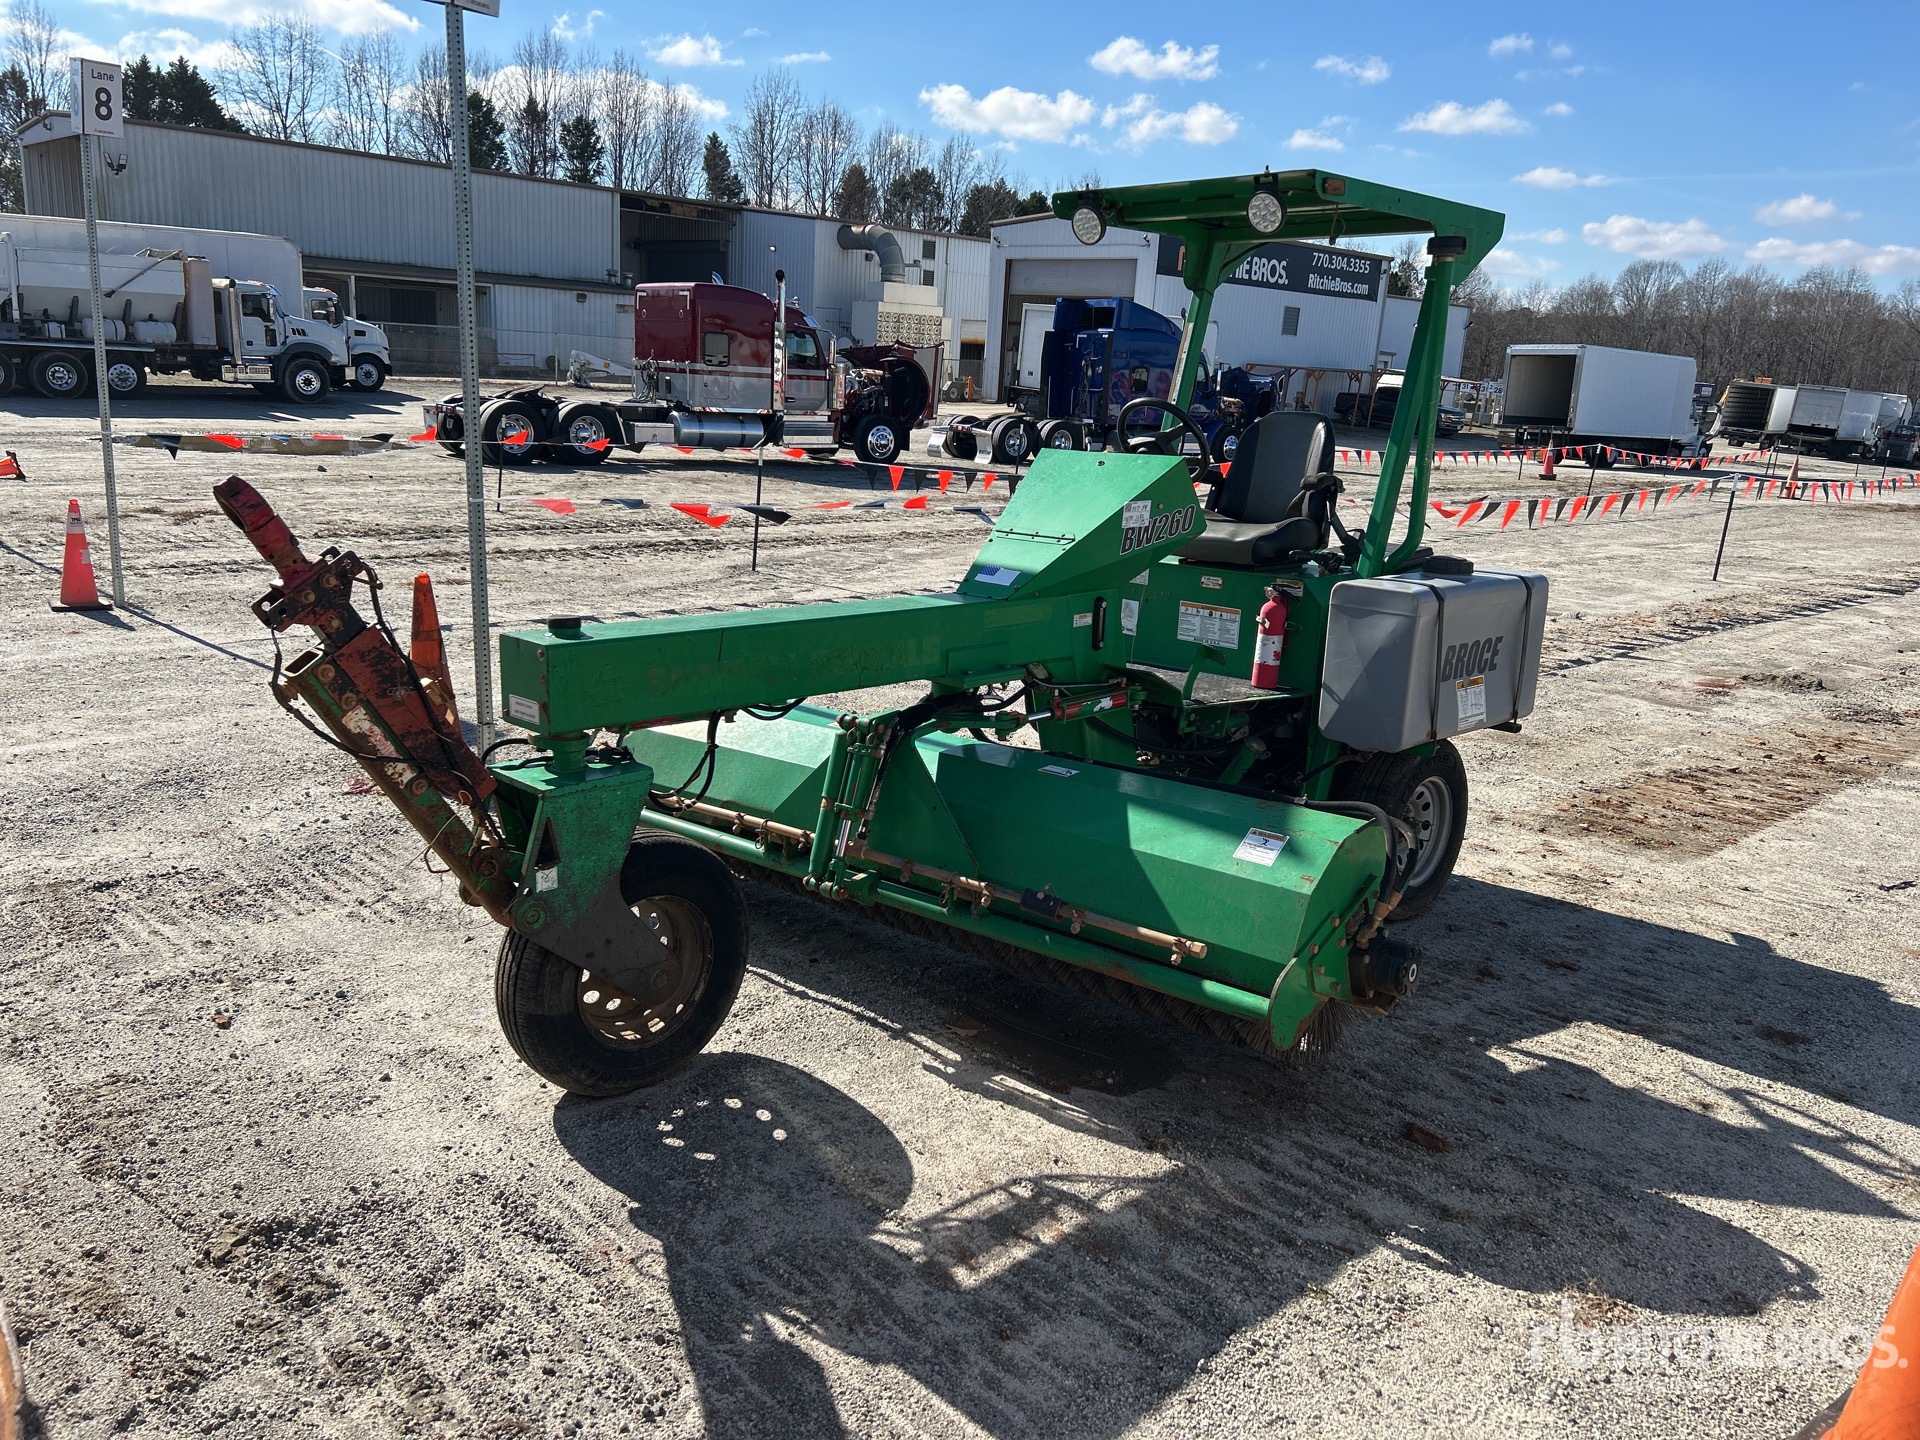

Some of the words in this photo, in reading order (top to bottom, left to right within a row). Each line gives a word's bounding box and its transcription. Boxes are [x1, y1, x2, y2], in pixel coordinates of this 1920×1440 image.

[91, 68, 115, 82] Lane
[94, 86, 113, 121] 8
[1251, 255, 1289, 286] BROS.
[1312, 251, 1371, 275] 770.304.3355
[1307, 273, 1369, 296] RitchieBros.com
[1119, 503, 1197, 556] BW260
[1439, 635, 1504, 683] BROCE
